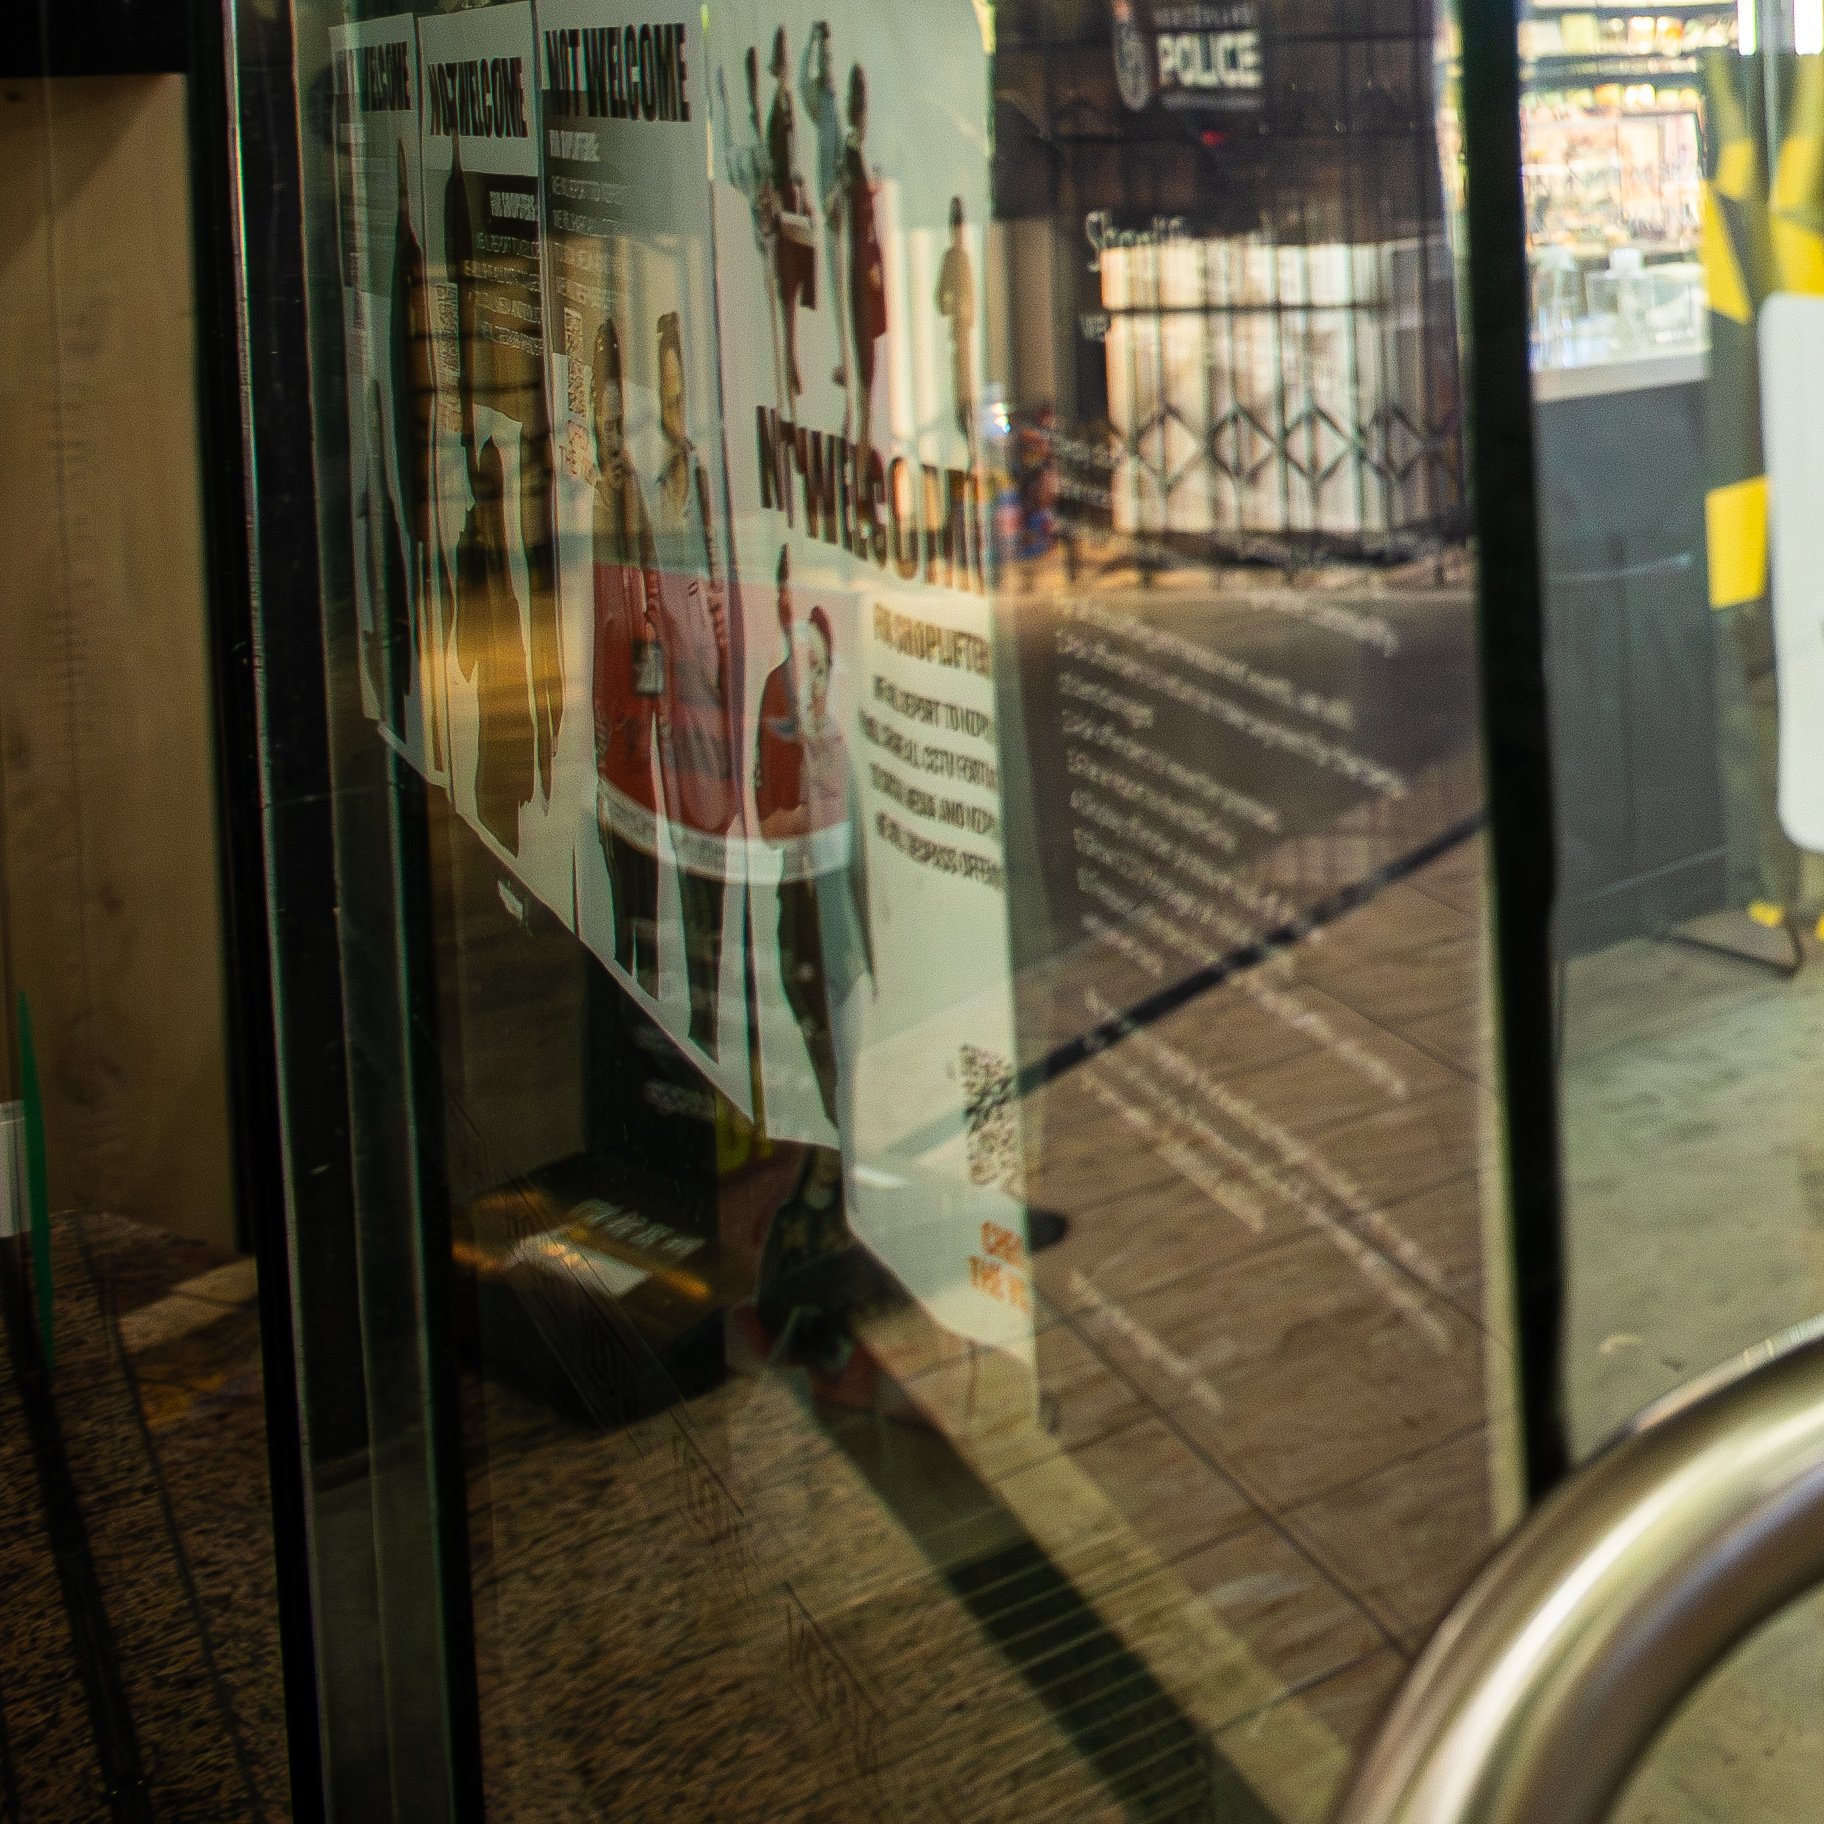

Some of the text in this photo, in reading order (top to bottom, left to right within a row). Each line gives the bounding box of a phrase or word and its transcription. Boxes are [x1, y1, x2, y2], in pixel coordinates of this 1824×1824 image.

[544, 22, 692, 123] NOT WELCOME
[1158, 31, 1264, 89] POLICE
